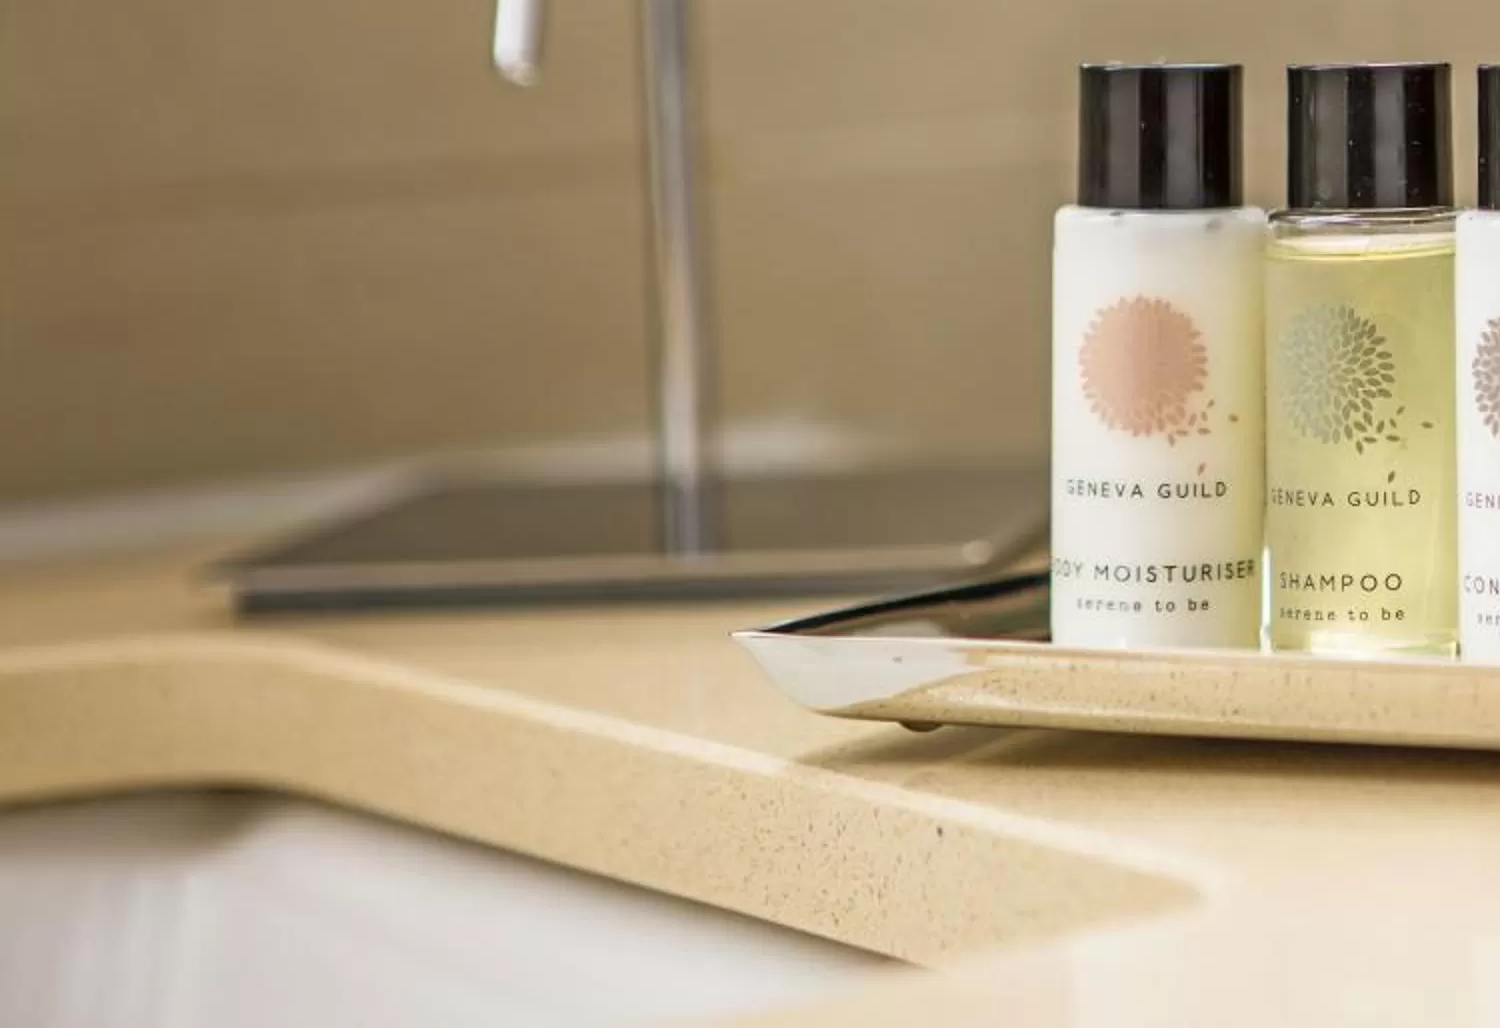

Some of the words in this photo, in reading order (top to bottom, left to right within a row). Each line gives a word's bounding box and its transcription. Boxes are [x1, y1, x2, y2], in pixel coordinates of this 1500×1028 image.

[1066, 478, 1145, 499] GENEVA
[1157, 480, 1228, 500] GUILD
[1271, 487, 1335, 507] GENEVA
[1346, 488, 1421, 507] GUILD
[1093, 559, 1256, 584] MOISTURISER
[1279, 571, 1403, 593] SHAMPOO
[1076, 597, 1143, 613] serene
[1154, 598, 1176, 613] to
[1187, 597, 1210, 612] be
[1279, 606, 1337, 622] serene
[1347, 608, 1369, 622] to
[1381, 606, 1406, 622] be
